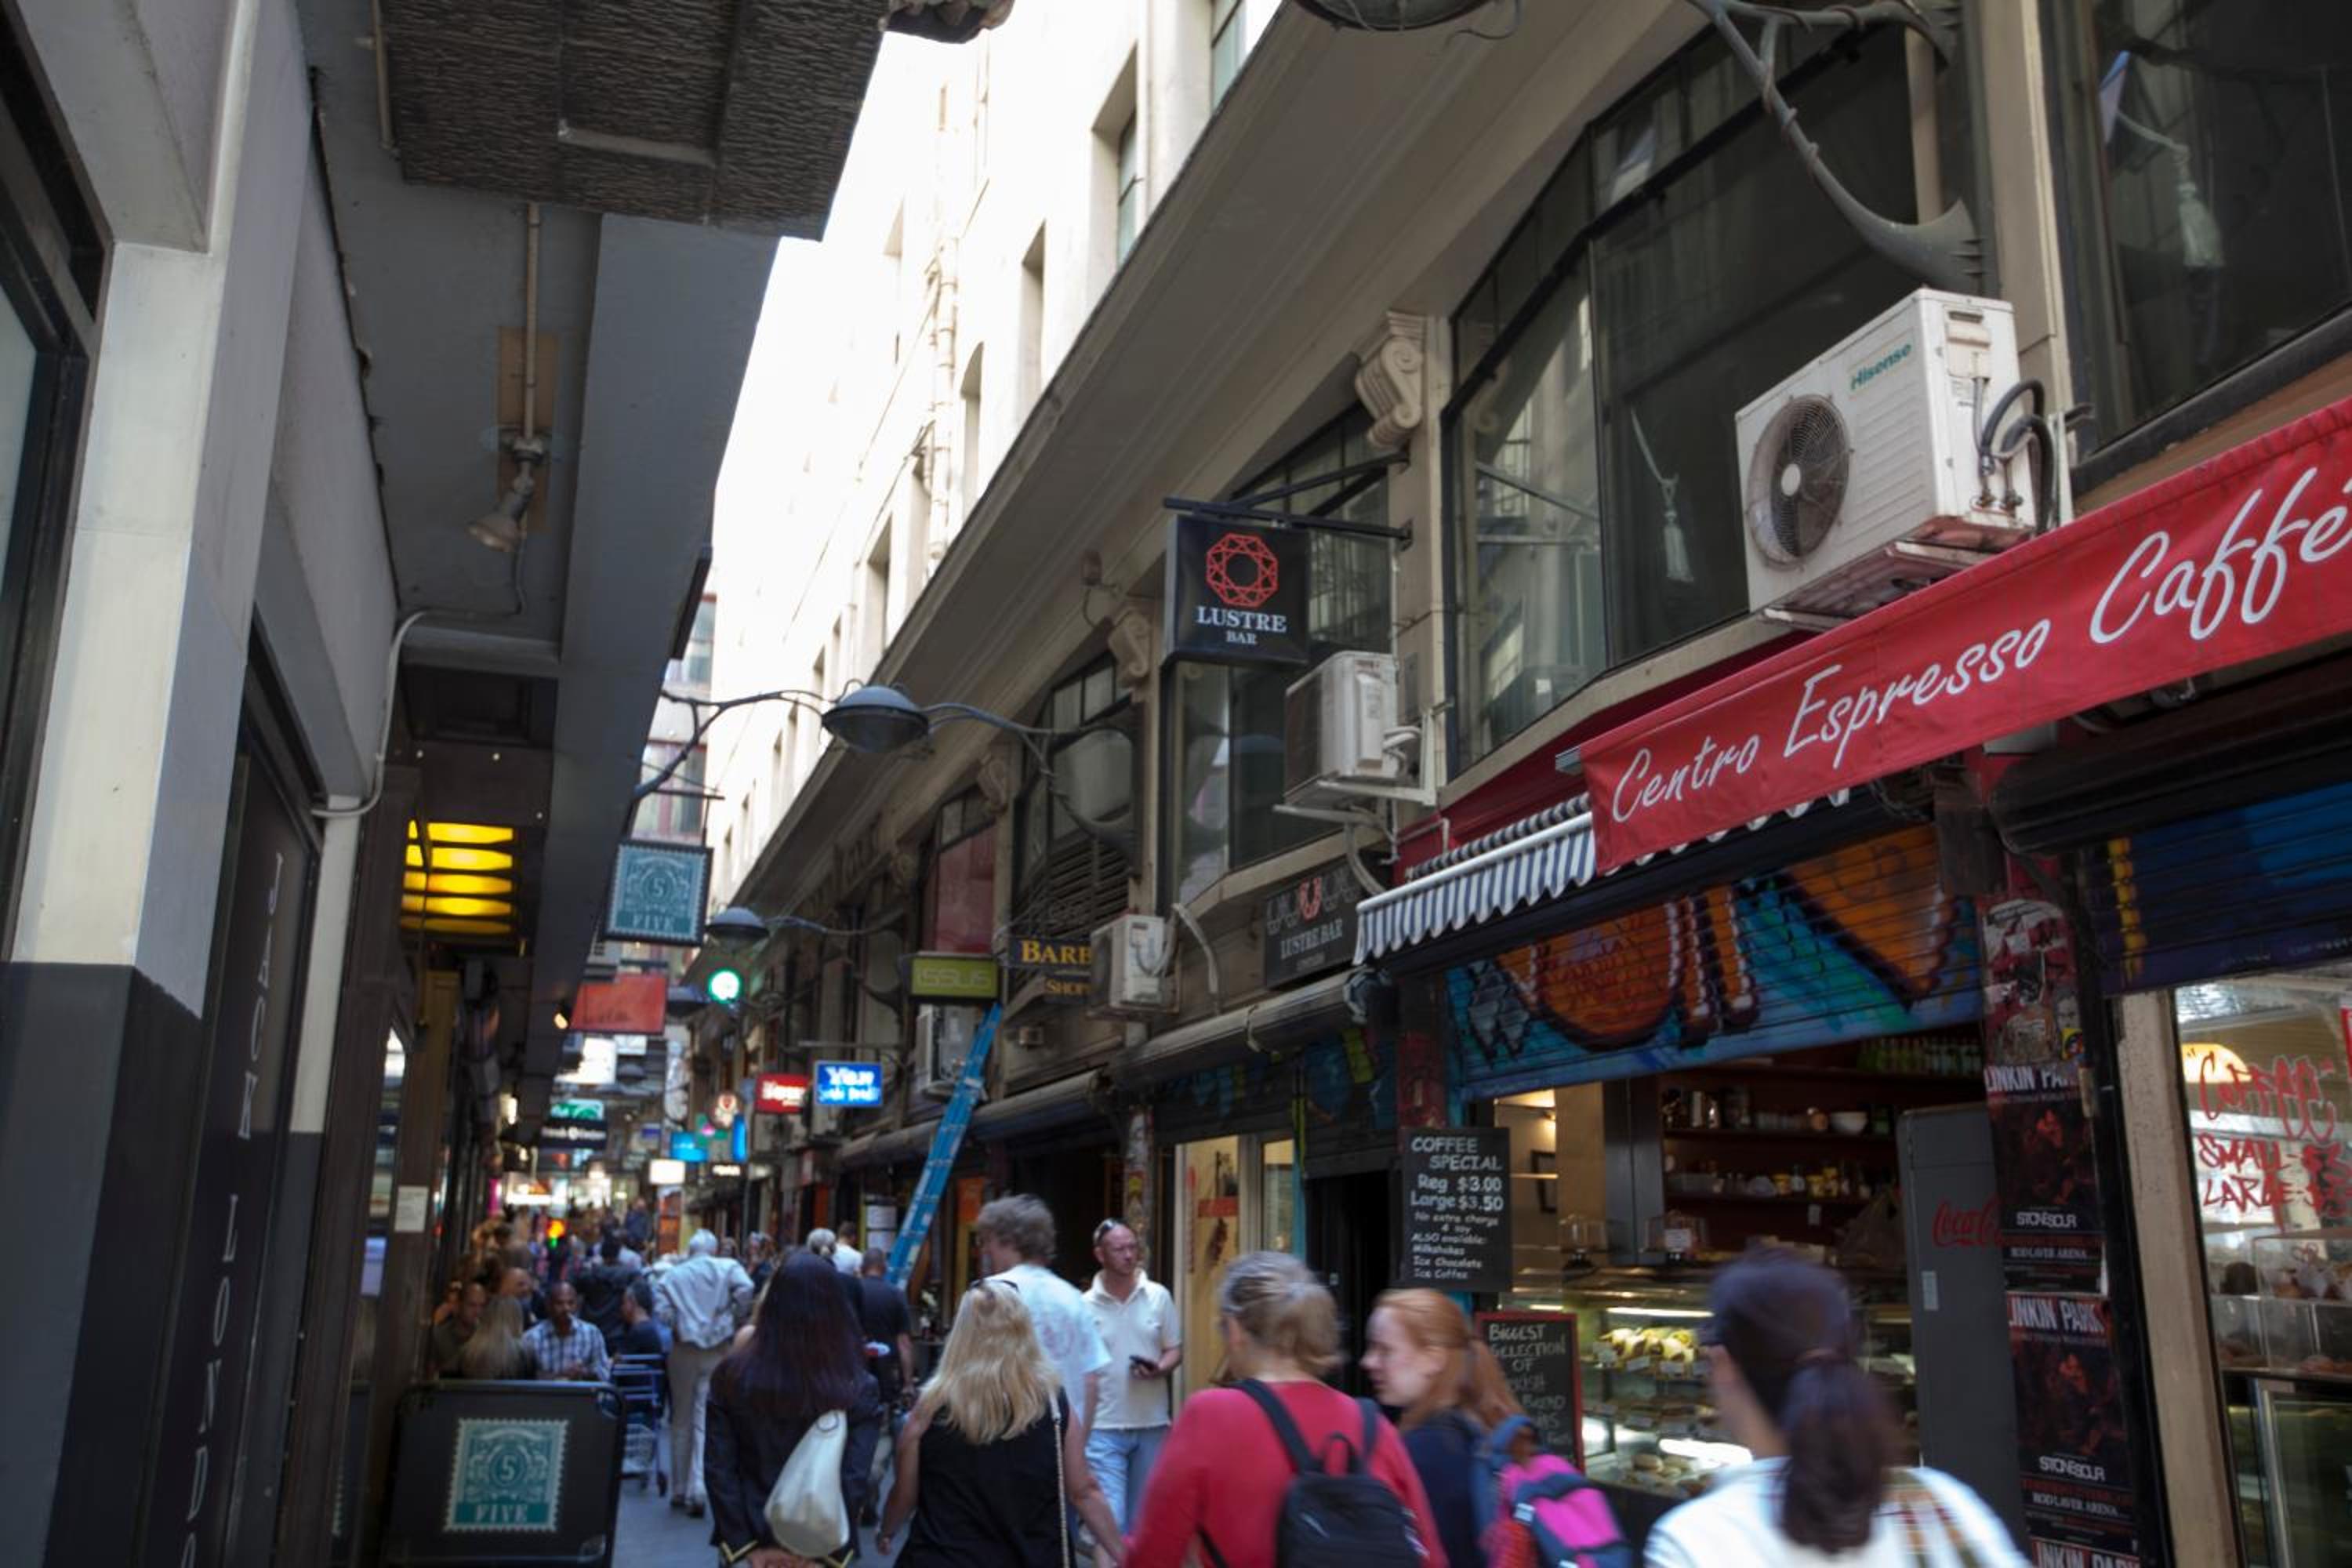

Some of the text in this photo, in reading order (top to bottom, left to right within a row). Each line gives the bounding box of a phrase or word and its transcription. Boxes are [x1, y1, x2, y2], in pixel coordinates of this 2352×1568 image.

[1850, 343, 1913, 390] Hisense
[1196, 606, 1287, 633] LUSTRE
[1226, 630, 1258, 644] BAR
[1612, 734, 1760, 824] Centro
[1784, 617, 2052, 768] Espresso
[1412, 1138, 1478, 1153] COFFEE
[1429, 1155, 1503, 1171] SPECIAL
[1417, 1174, 1502, 1193] Reg $3.00
[1411, 1191, 1504, 1211] Large $3.50
[1411, 1232, 1440, 1243] ALSO
[500, 1455, 516, 1480] 5
[476, 1504, 528, 1523] FIVE
